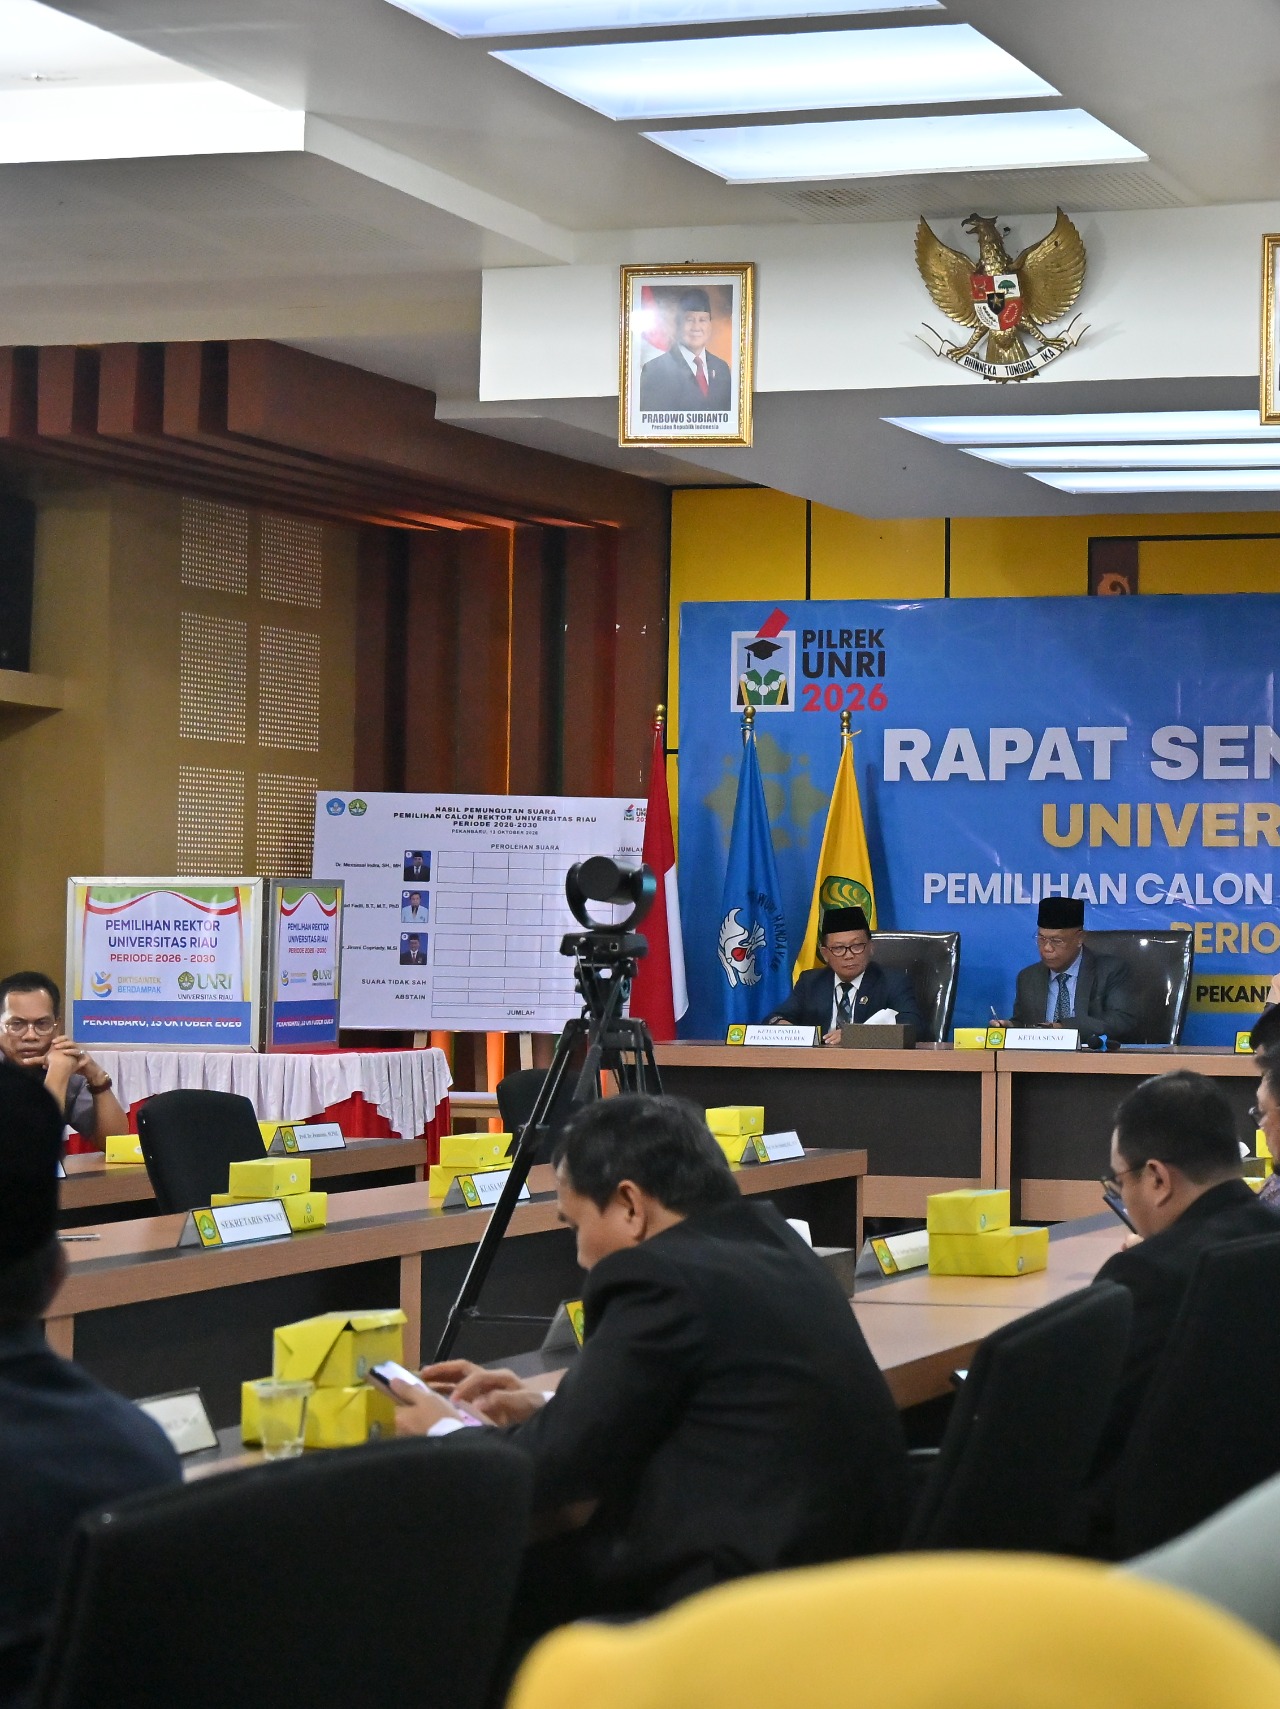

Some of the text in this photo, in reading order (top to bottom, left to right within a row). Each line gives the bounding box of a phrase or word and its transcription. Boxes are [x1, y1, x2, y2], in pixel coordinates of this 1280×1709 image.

[964, 348, 1056, 376] BHINNEKA TUNGGAL IKA
[642, 413, 729, 423] PRABOWO SUBIANTO
[802, 628, 885, 649] PILREK
[802, 650, 886, 678] UNRI
[802, 683, 888, 712] 2026
[884, 726, 1127, 782] RAPAT
[924, 873, 1127, 905] PEMILIHAN
[1135, 873, 1273, 906] CALON
[106, 920, 220, 932] PEMILIHAN REKTOR
[288, 923, 330, 931] PEMILIHAN REKTOR
[109, 937, 218, 948] UNIVERSITAS RIAU
[110, 954, 153, 962] PERIODE
[156, 954, 181, 963] 2026
[190, 954, 216, 963] 2030
[118, 976, 161, 984] DIKTISAINTEK
[197, 974, 233, 990] UNRI
[118, 986, 161, 994] BERDAMPAK
[1196, 986, 1271, 1003] PEKAN
[220, 1212, 283, 1230] SEKRETARIS SENAT
